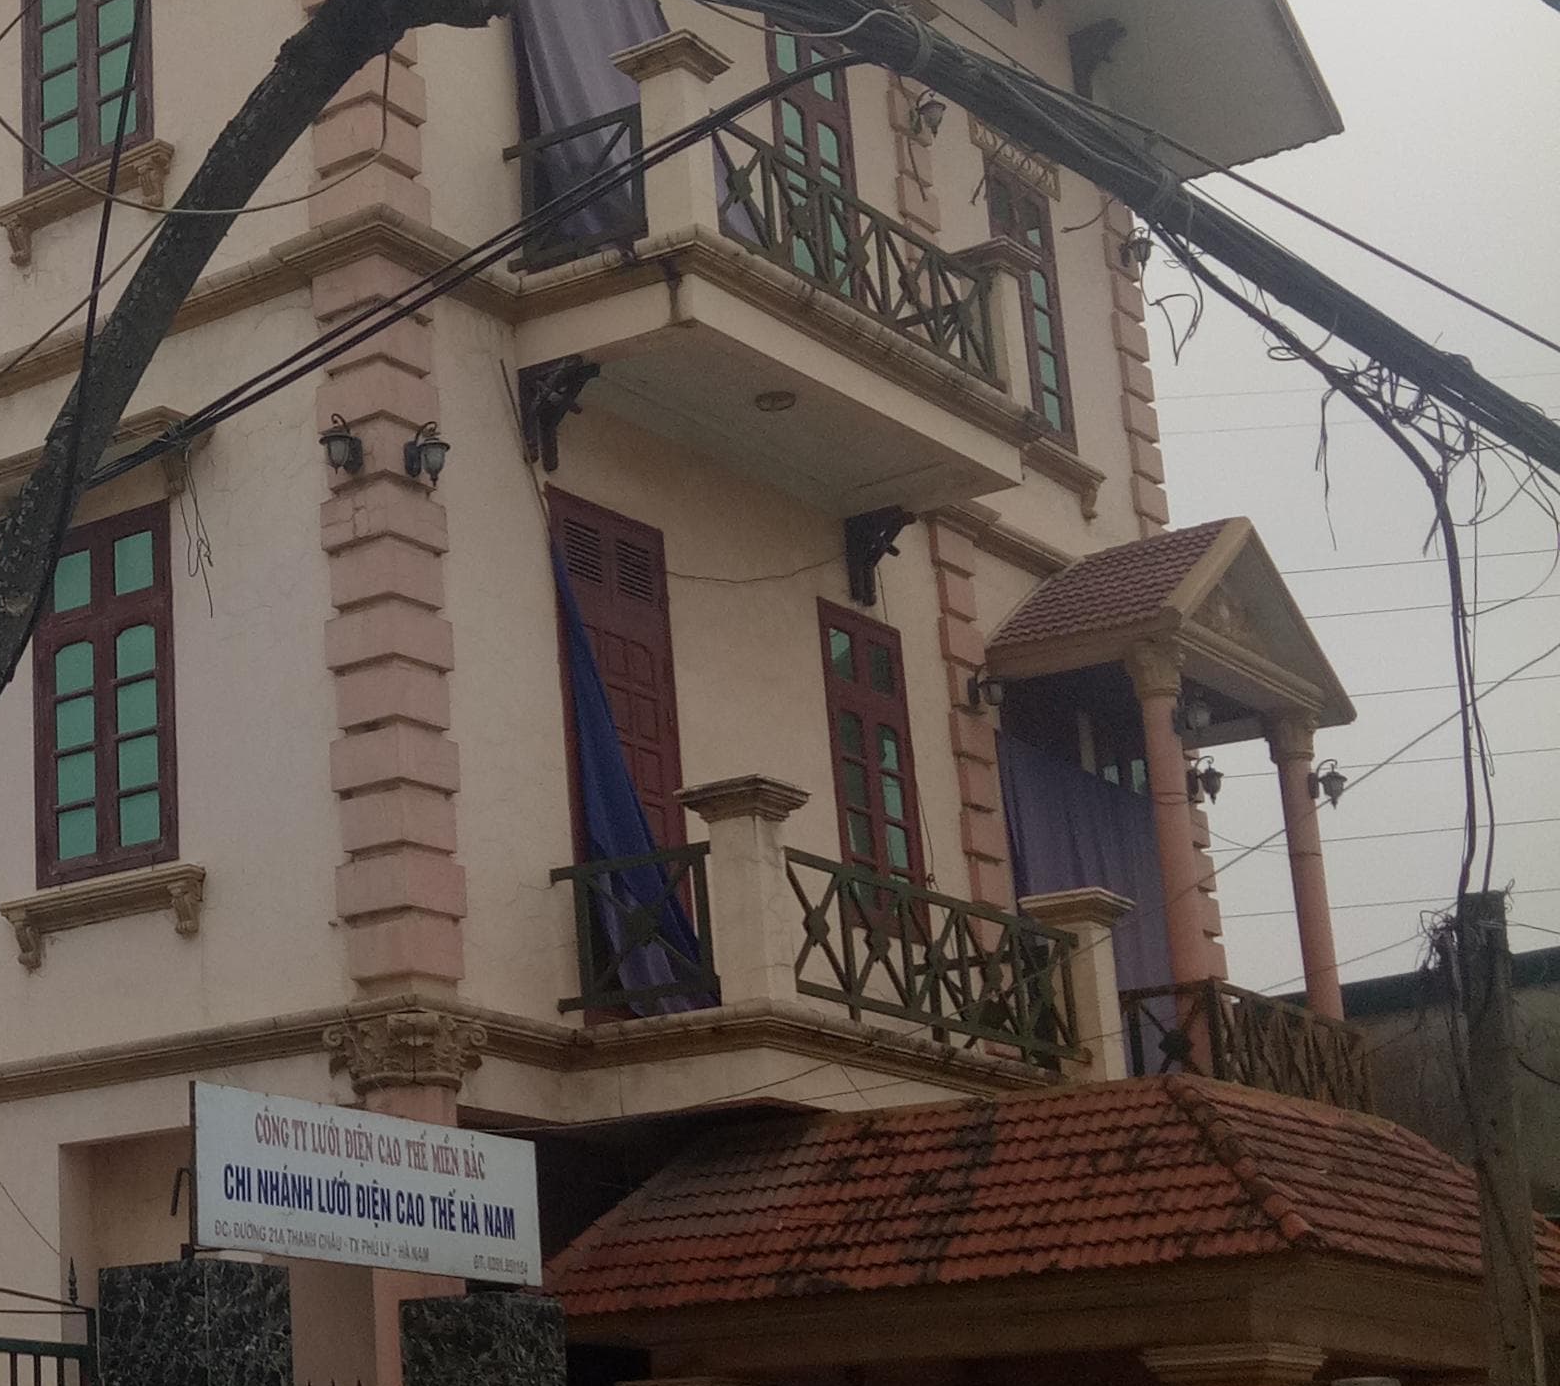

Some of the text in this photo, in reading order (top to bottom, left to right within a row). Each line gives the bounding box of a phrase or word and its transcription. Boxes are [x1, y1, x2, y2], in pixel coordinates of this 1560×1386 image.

[255, 1106, 289, 1148] CÔNG
[292, 1119, 308, 1152] TY
[344, 1123, 375, 1168] ĐIỆN
[378, 1133, 401, 1167] CAO
[405, 1129, 429, 1172] THẾ
[224, 1163, 516, 1241] CHI NHÁNH LƯỚI ĐIỆN CAO THẾ HÀ NAM
